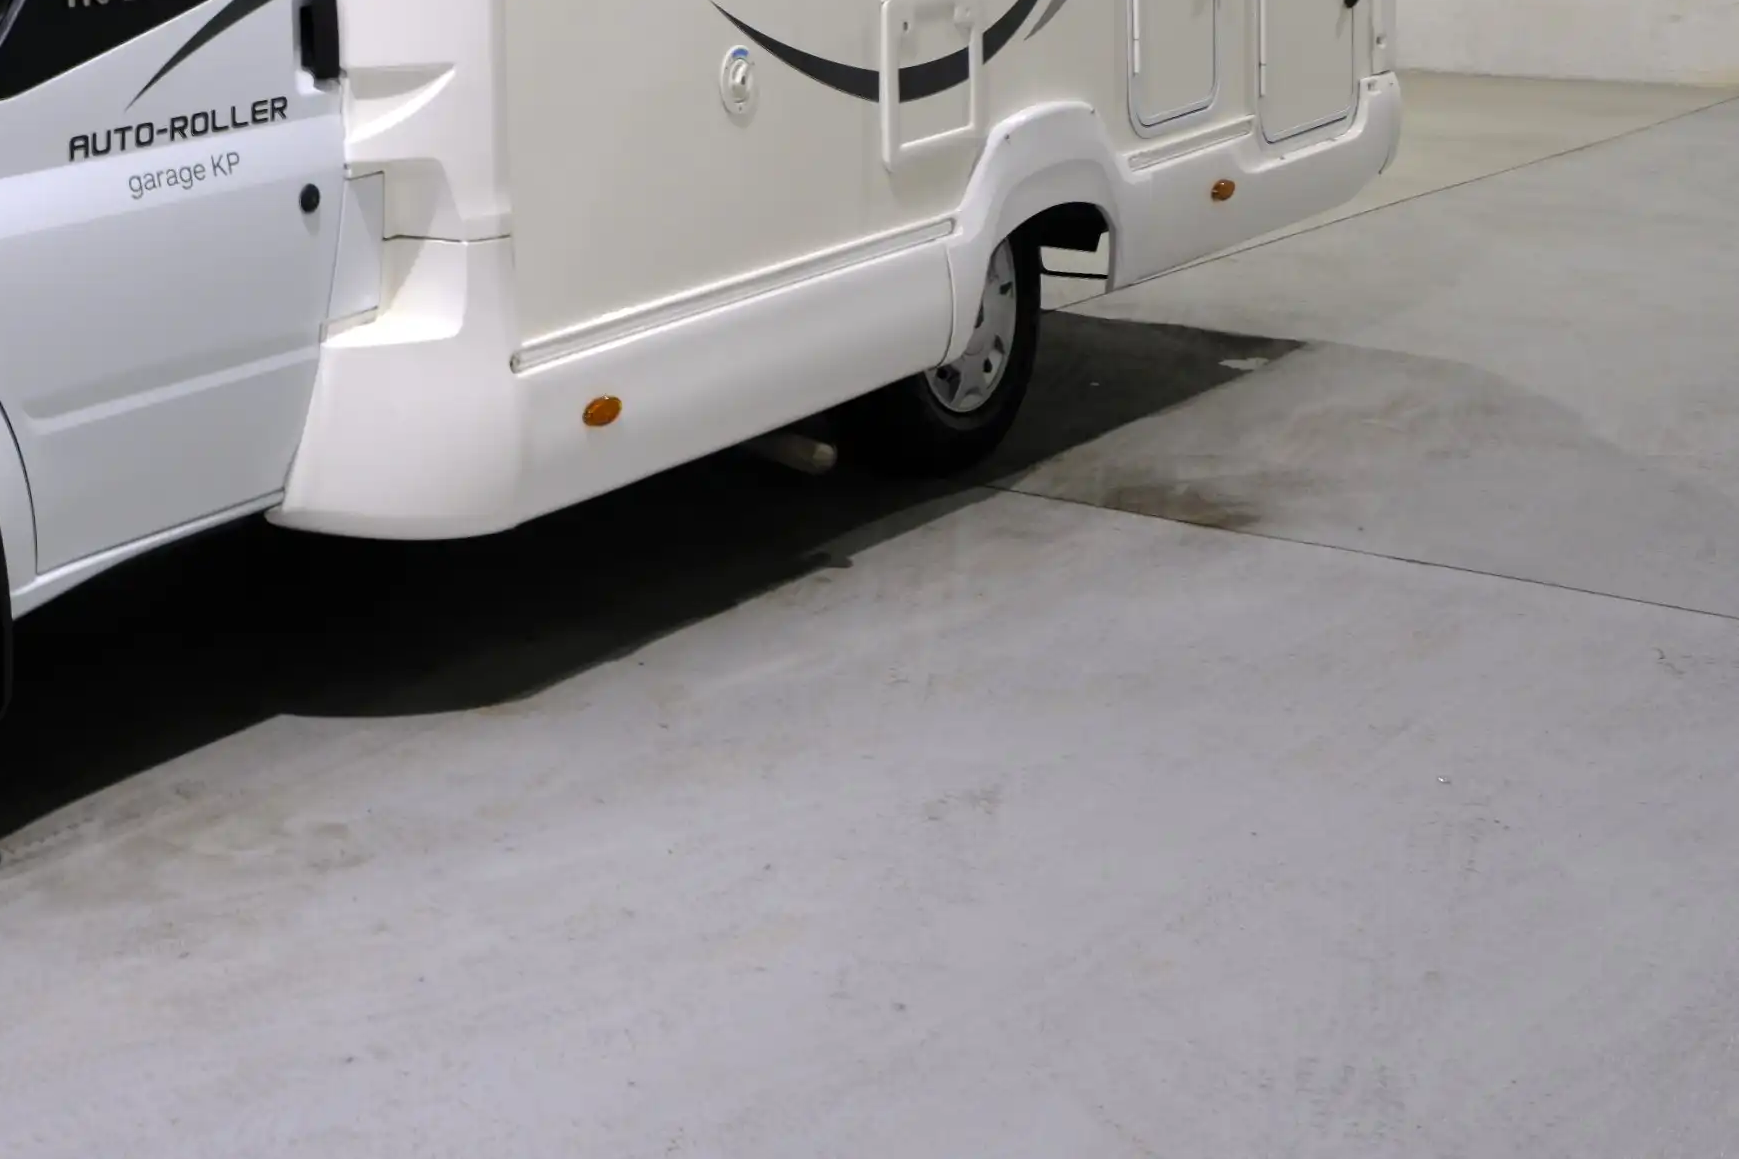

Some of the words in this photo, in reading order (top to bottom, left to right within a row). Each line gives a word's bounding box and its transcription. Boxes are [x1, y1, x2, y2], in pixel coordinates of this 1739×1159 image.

[68, 96, 288, 162] AUTO-ROLLER
[128, 163, 206, 199] garage
[211, 151, 240, 178] KP
